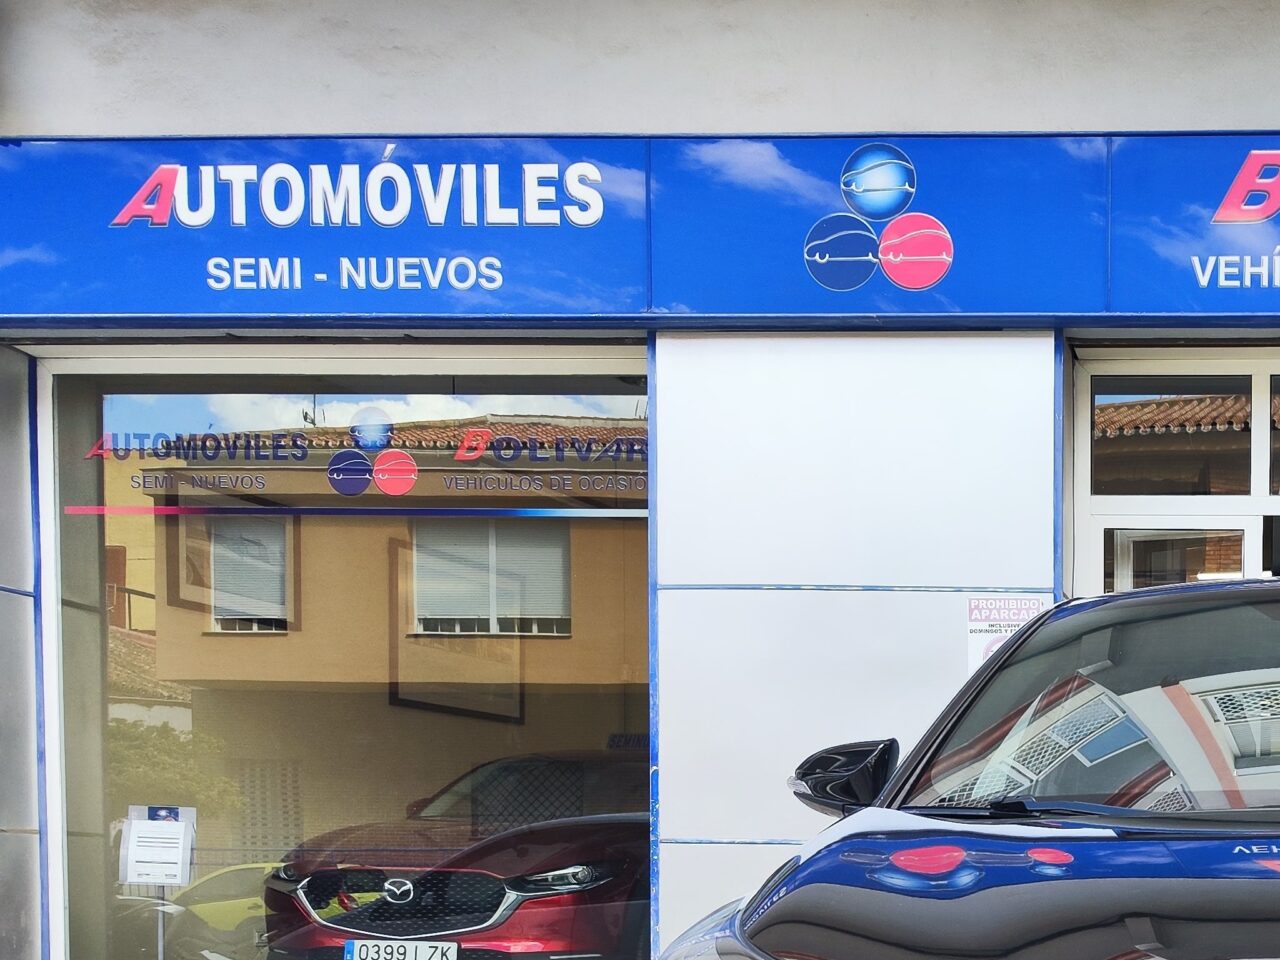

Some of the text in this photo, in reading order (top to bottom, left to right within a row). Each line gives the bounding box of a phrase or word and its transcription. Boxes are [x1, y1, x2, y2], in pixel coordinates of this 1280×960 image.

[109, 143, 605, 228] AUTOMÓVILES
[206, 256, 303, 290] SEMI
[340, 255, 504, 291] NUEVOS
[131, 475, 174, 490] SEMI
[191, 474, 267, 490] NUEVOS
[551, 475, 574, 491] DE
[579, 471, 648, 491] OCASIÓ
[970, 599, 1039, 609] PROHIBIDO
